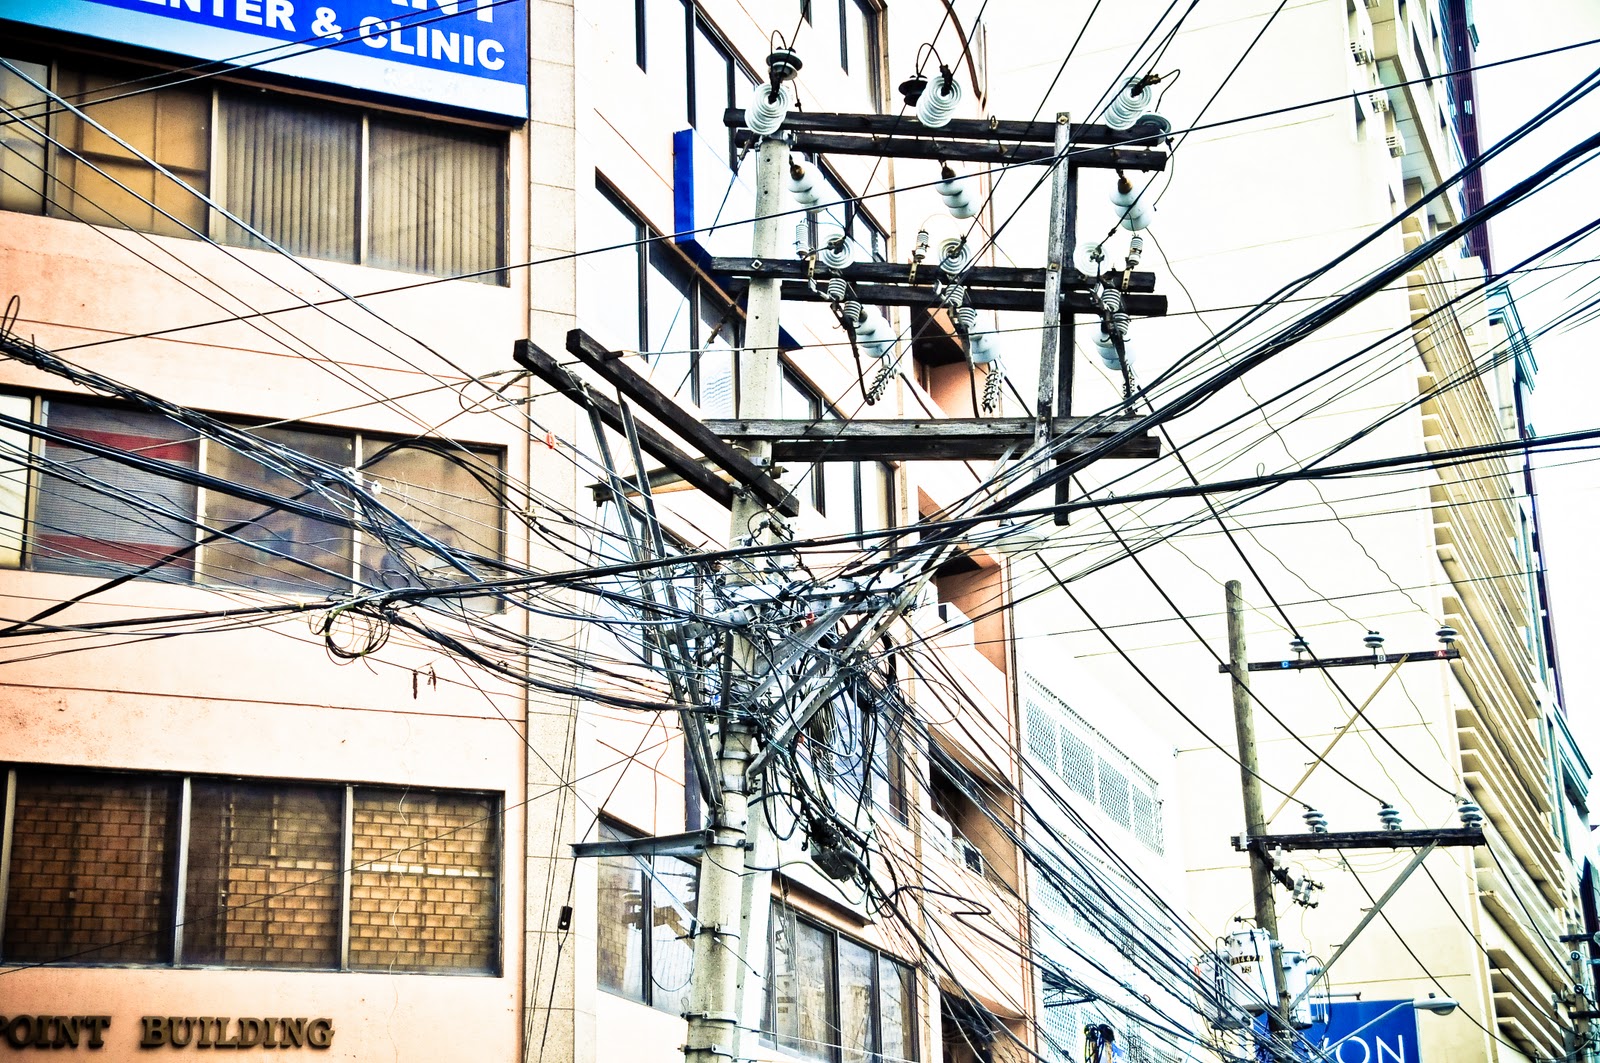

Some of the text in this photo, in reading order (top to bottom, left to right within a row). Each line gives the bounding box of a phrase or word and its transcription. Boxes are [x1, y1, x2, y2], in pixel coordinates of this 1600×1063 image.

[311, 7, 344, 41] &
[360, 16, 505, 71] CLINIC
[140, 1016, 335, 1050] BUILDING
